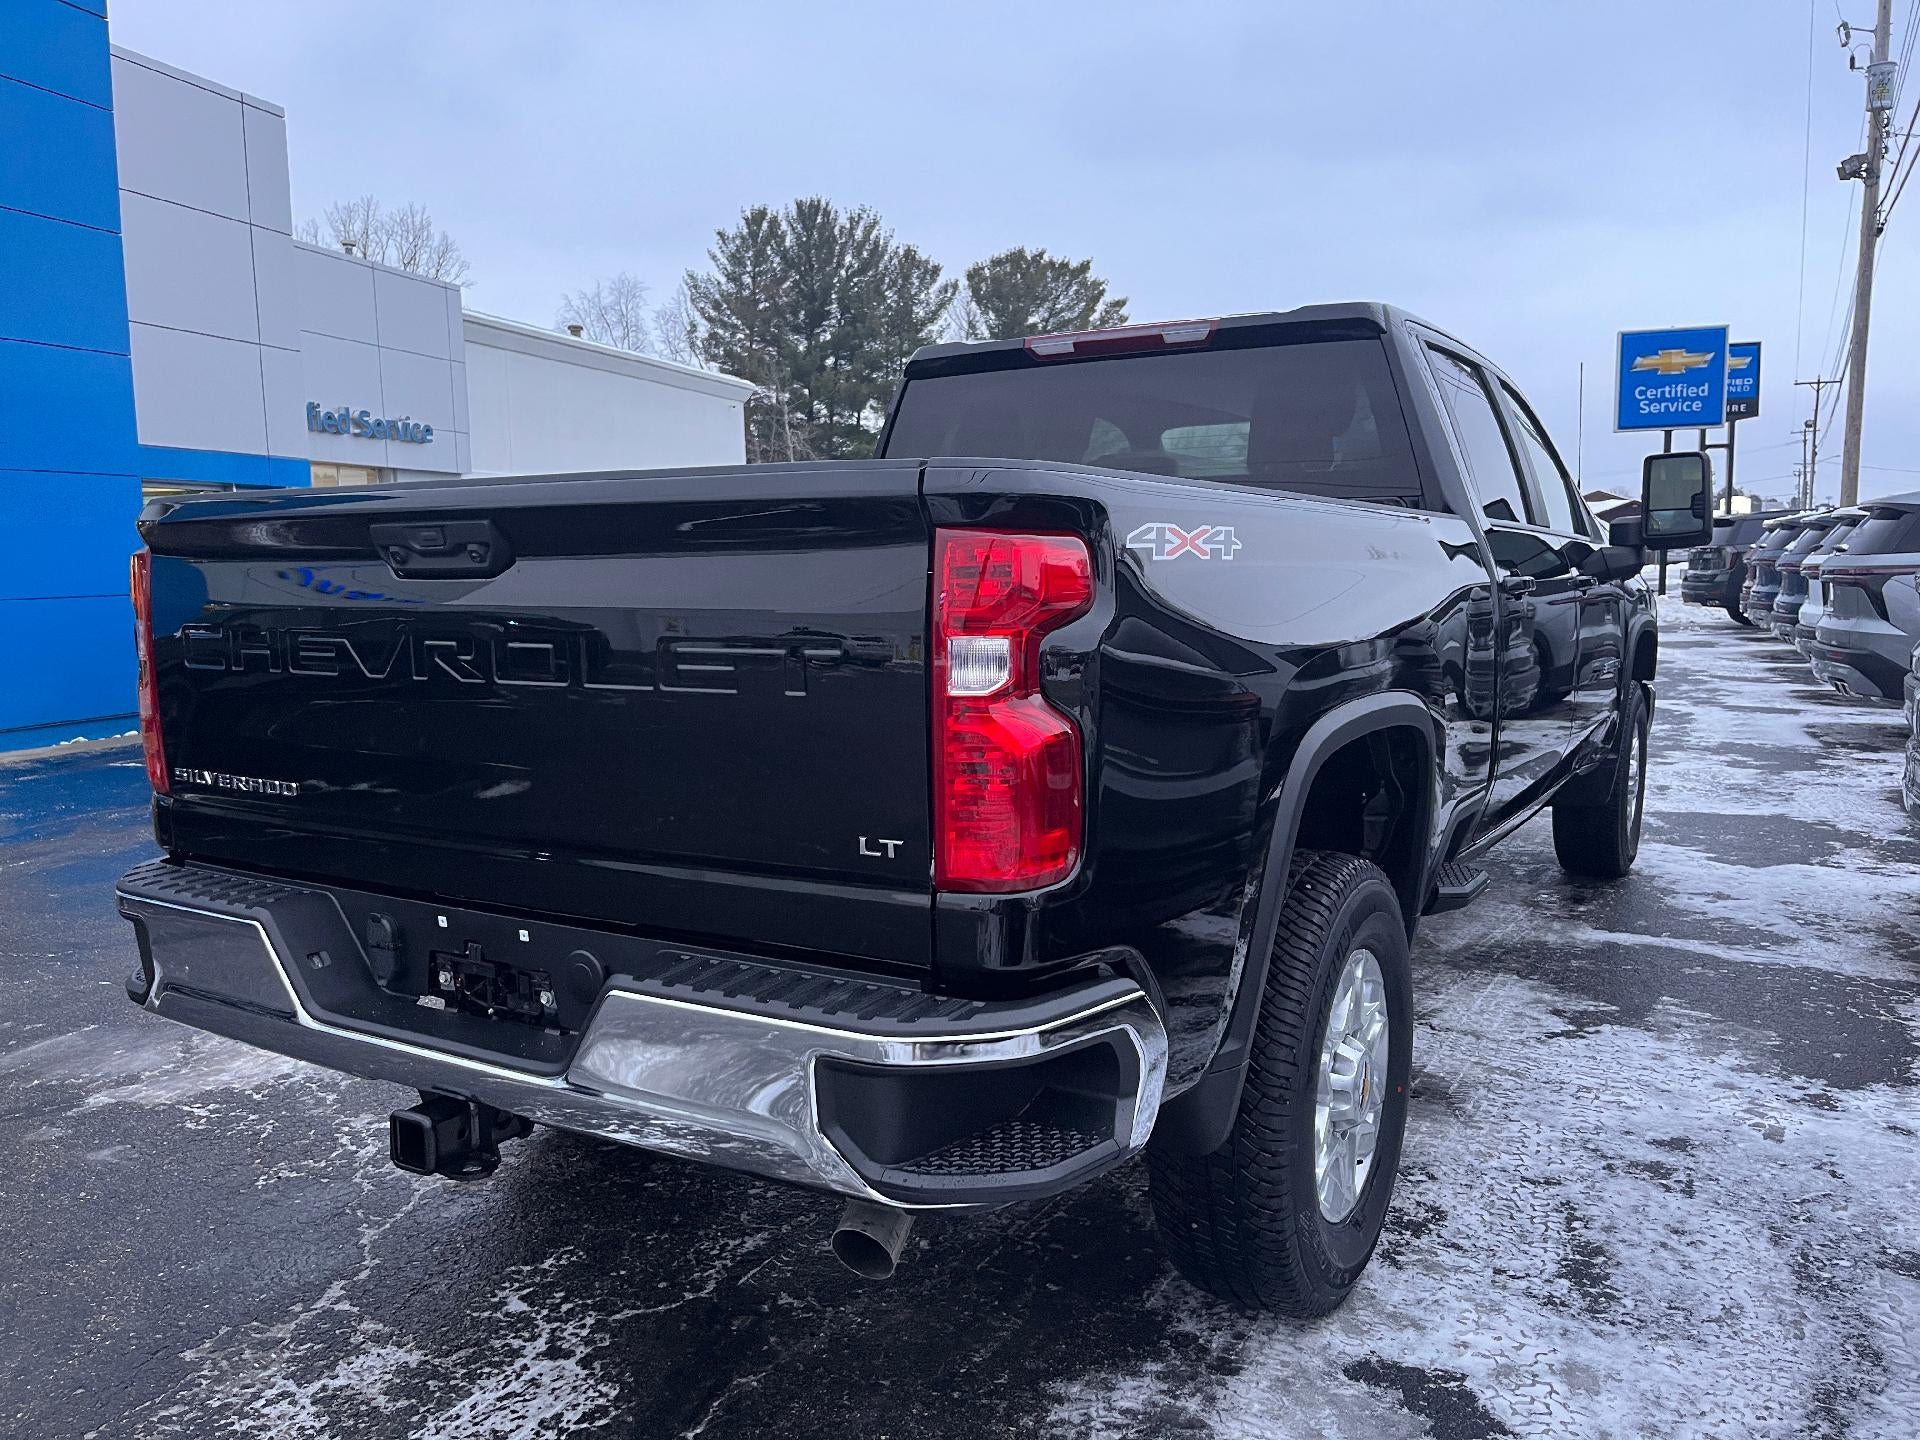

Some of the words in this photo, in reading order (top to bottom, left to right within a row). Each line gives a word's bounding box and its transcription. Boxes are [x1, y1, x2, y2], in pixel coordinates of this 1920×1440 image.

[1634, 382, 1709, 399] Certified
[1639, 399, 1702, 414] Service
[306, 401, 350, 435] fied
[354, 410, 434, 444] Service
[182, 622, 842, 697] CHEVROLET
[174, 767, 300, 797] SILVERADO
[858, 835, 904, 859] LT
